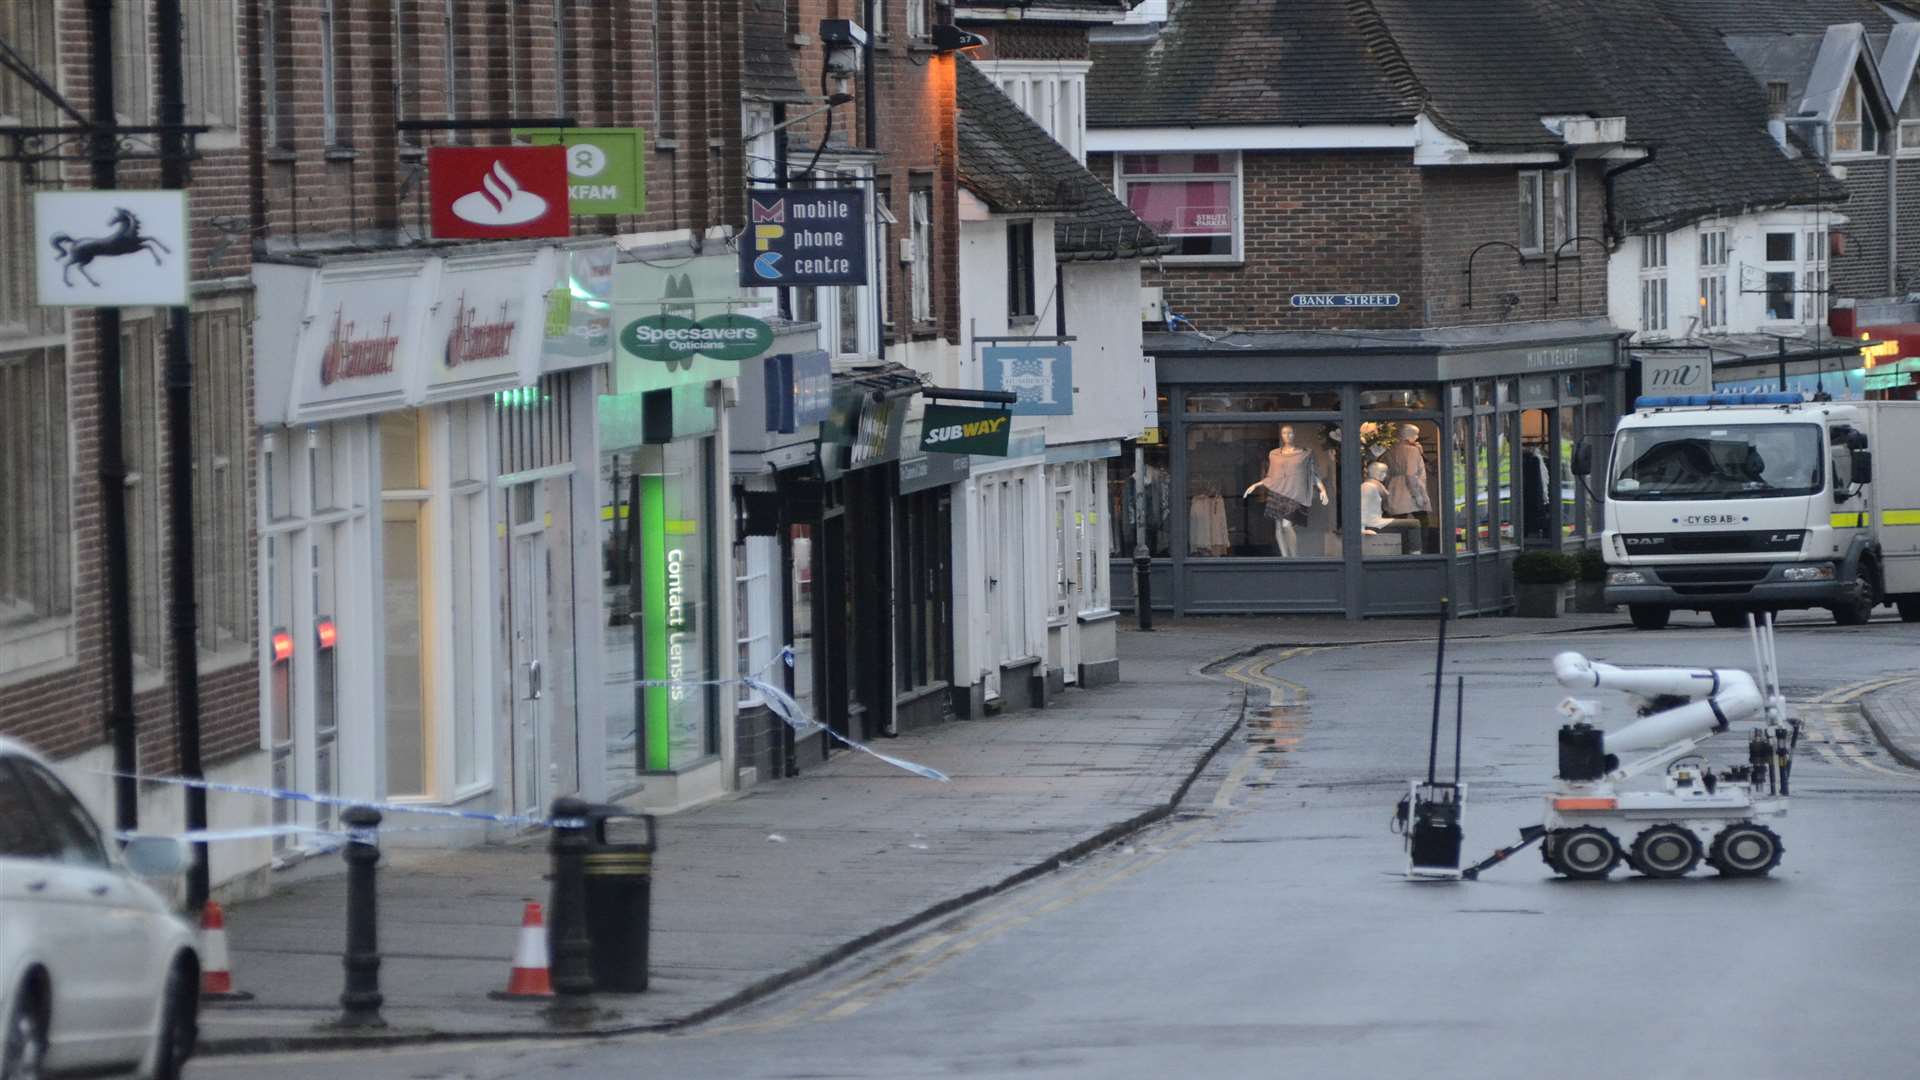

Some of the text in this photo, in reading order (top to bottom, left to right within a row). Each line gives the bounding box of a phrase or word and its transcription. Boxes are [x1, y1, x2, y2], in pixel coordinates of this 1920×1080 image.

[959, 35, 972, 43] 37
[568, 185, 617, 200] XFAM
[752, 198, 784, 223] M
[792, 200, 848, 219] mobile
[755, 224, 784, 251] P
[793, 229, 844, 250] phone
[794, 256, 849, 274] centre
[1299, 295, 1392, 305] BANK STREET
[636, 325, 758, 343] Specsavers
[669, 340, 726, 351] Opticians
[924, 416, 1008, 444] SUBWAY
[1703, 514, 1717, 524] 69
[1626, 537, 1665, 545] DAF
[1770, 534, 1801, 542] LF
[667, 548, 684, 626] Contact
[669, 632, 685, 701] Lenss
